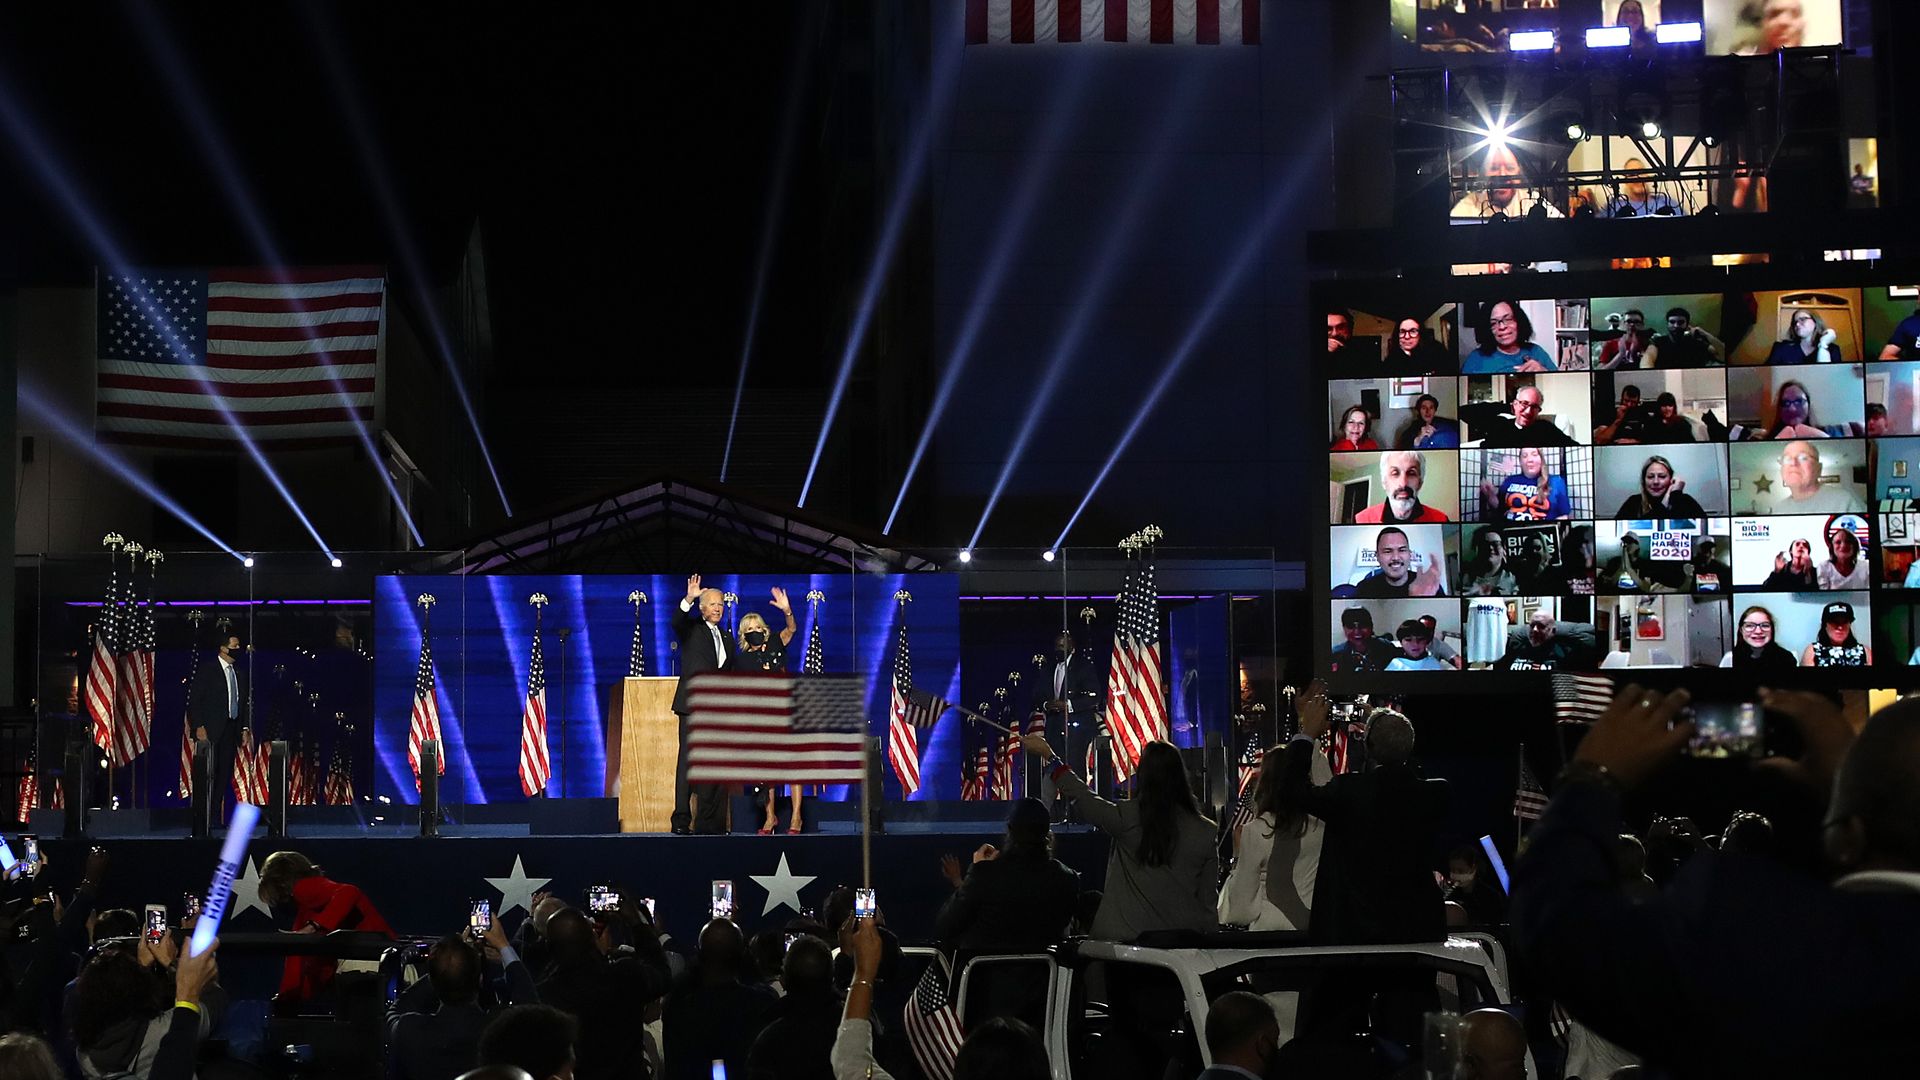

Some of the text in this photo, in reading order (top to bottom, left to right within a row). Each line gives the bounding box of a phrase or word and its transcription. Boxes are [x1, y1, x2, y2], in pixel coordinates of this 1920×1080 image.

[1507, 533, 1554, 547] BIN
[1651, 532, 1690, 540] BIDEN
[1651, 548, 1690, 557] 2020
